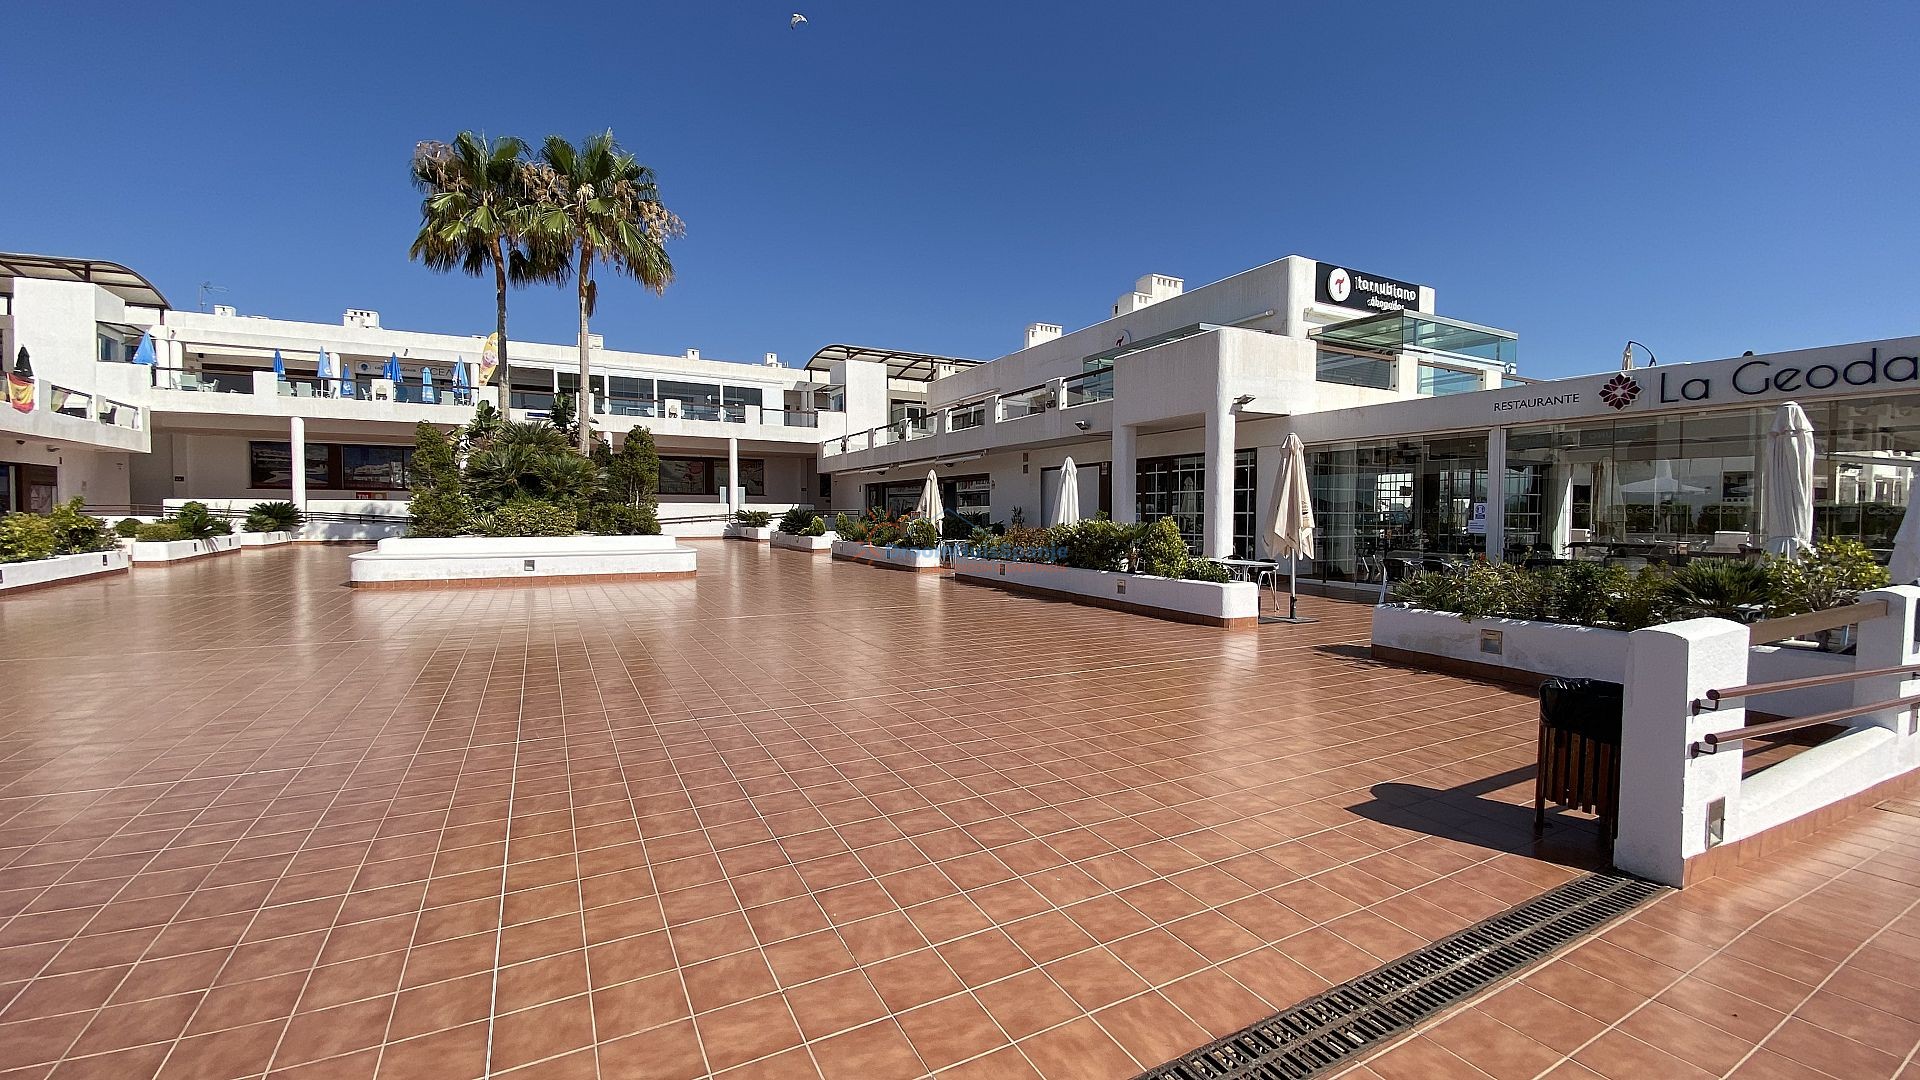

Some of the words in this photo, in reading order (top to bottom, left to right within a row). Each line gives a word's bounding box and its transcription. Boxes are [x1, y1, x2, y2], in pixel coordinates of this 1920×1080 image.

[1660, 372, 1710, 404] La
[1732, 348, 1918, 395] Geoda
[1493, 393, 1580, 412] RESTAURANTE
